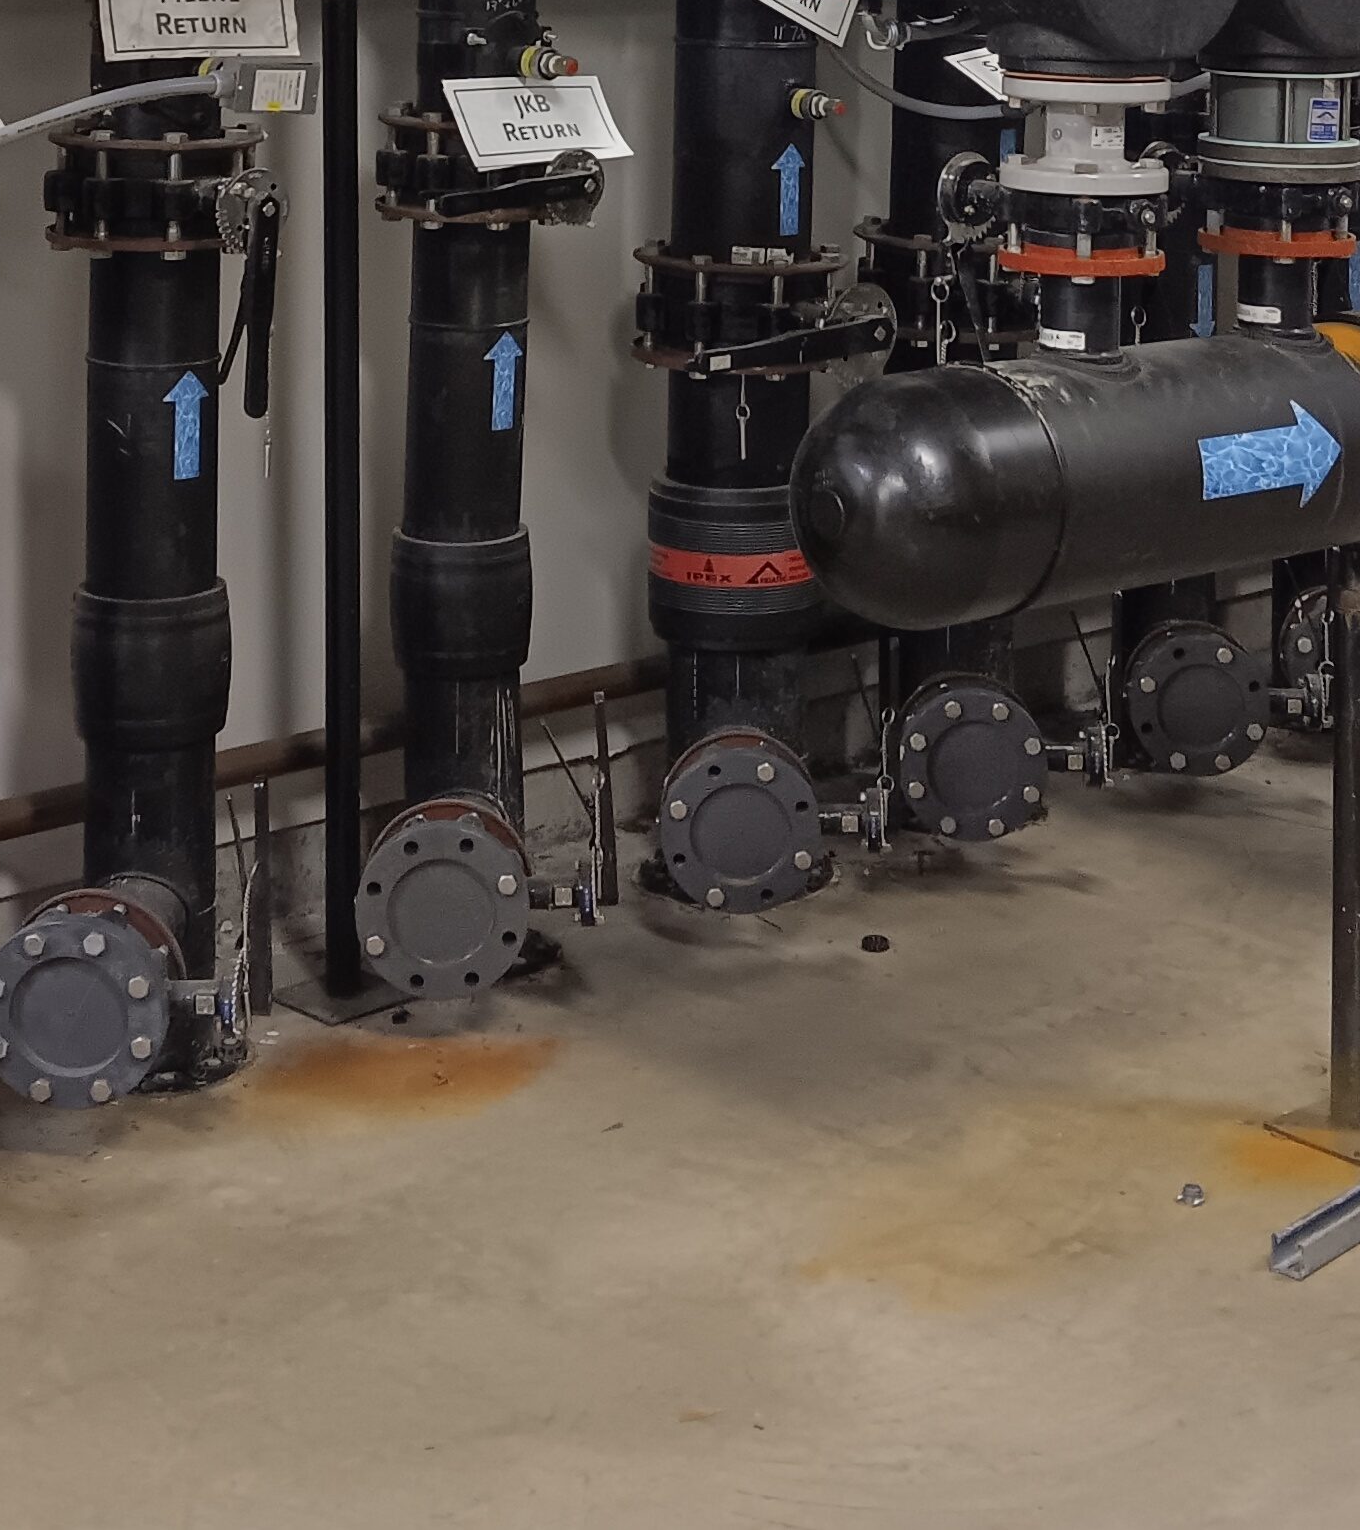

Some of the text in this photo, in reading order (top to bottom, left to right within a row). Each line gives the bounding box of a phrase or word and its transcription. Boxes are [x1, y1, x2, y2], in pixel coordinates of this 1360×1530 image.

[155, 12, 247, 35] RETURN
[513, 94, 551, 119] JKB
[502, 122, 582, 142] RETURN
[686, 571, 733, 584] IPEX
